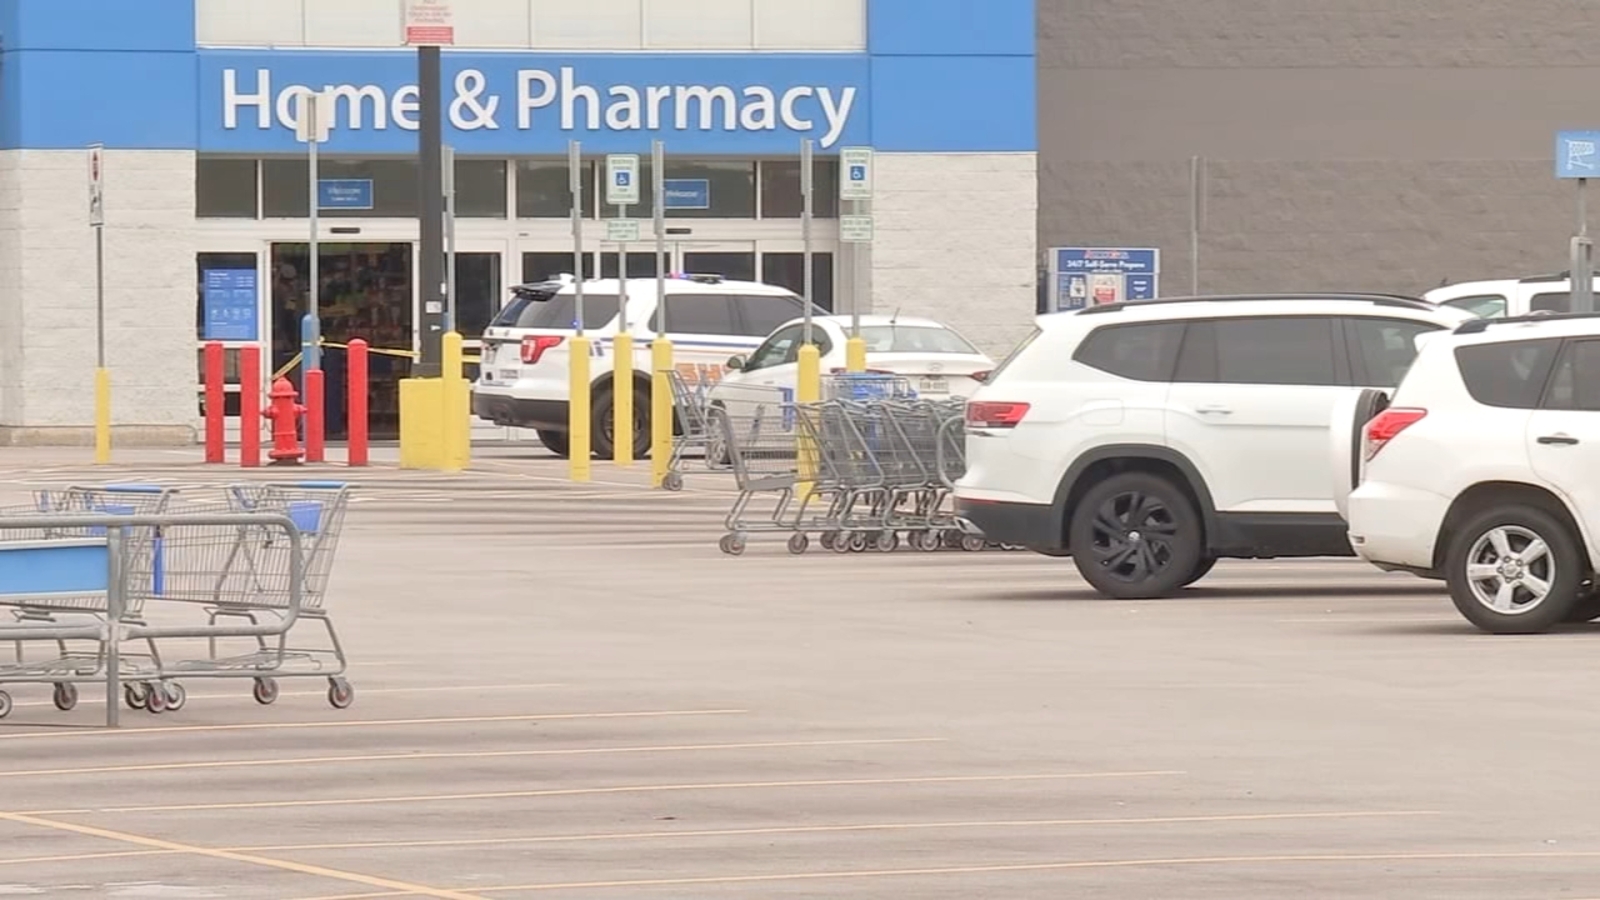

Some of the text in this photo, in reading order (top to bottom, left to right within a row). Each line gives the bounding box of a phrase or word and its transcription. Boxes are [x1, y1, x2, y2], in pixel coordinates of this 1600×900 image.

[222, 66, 856, 149] Home & Pharmacy
[1119, 259, 1146, 270] Propane
